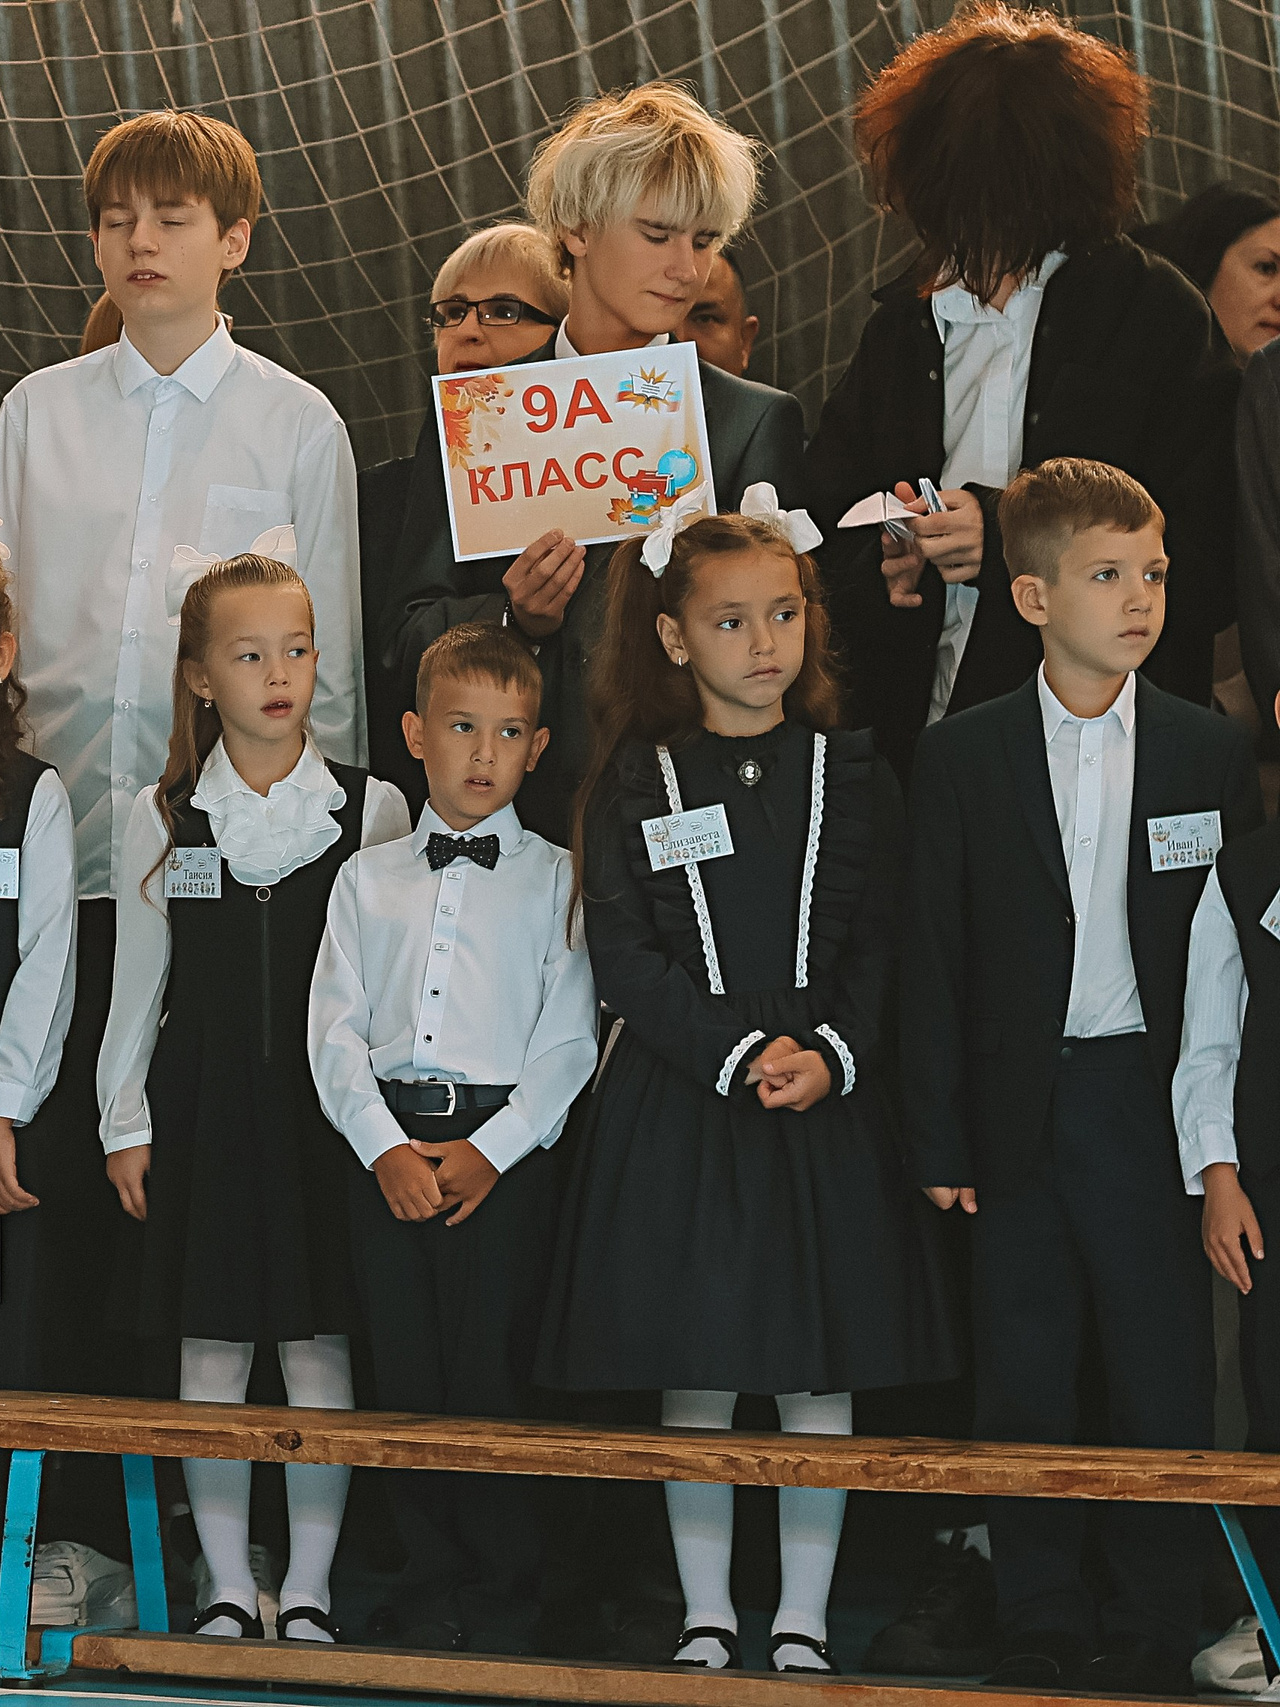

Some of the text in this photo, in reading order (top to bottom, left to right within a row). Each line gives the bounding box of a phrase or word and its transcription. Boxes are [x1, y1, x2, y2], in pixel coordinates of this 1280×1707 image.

[521, 377, 614, 434] 9А
[468, 446, 645, 506] КЛАСС
[661, 830, 720, 851] Елизавета
[1167, 840, 1193, 851] Иван
[183, 869, 213, 880] Таисия
